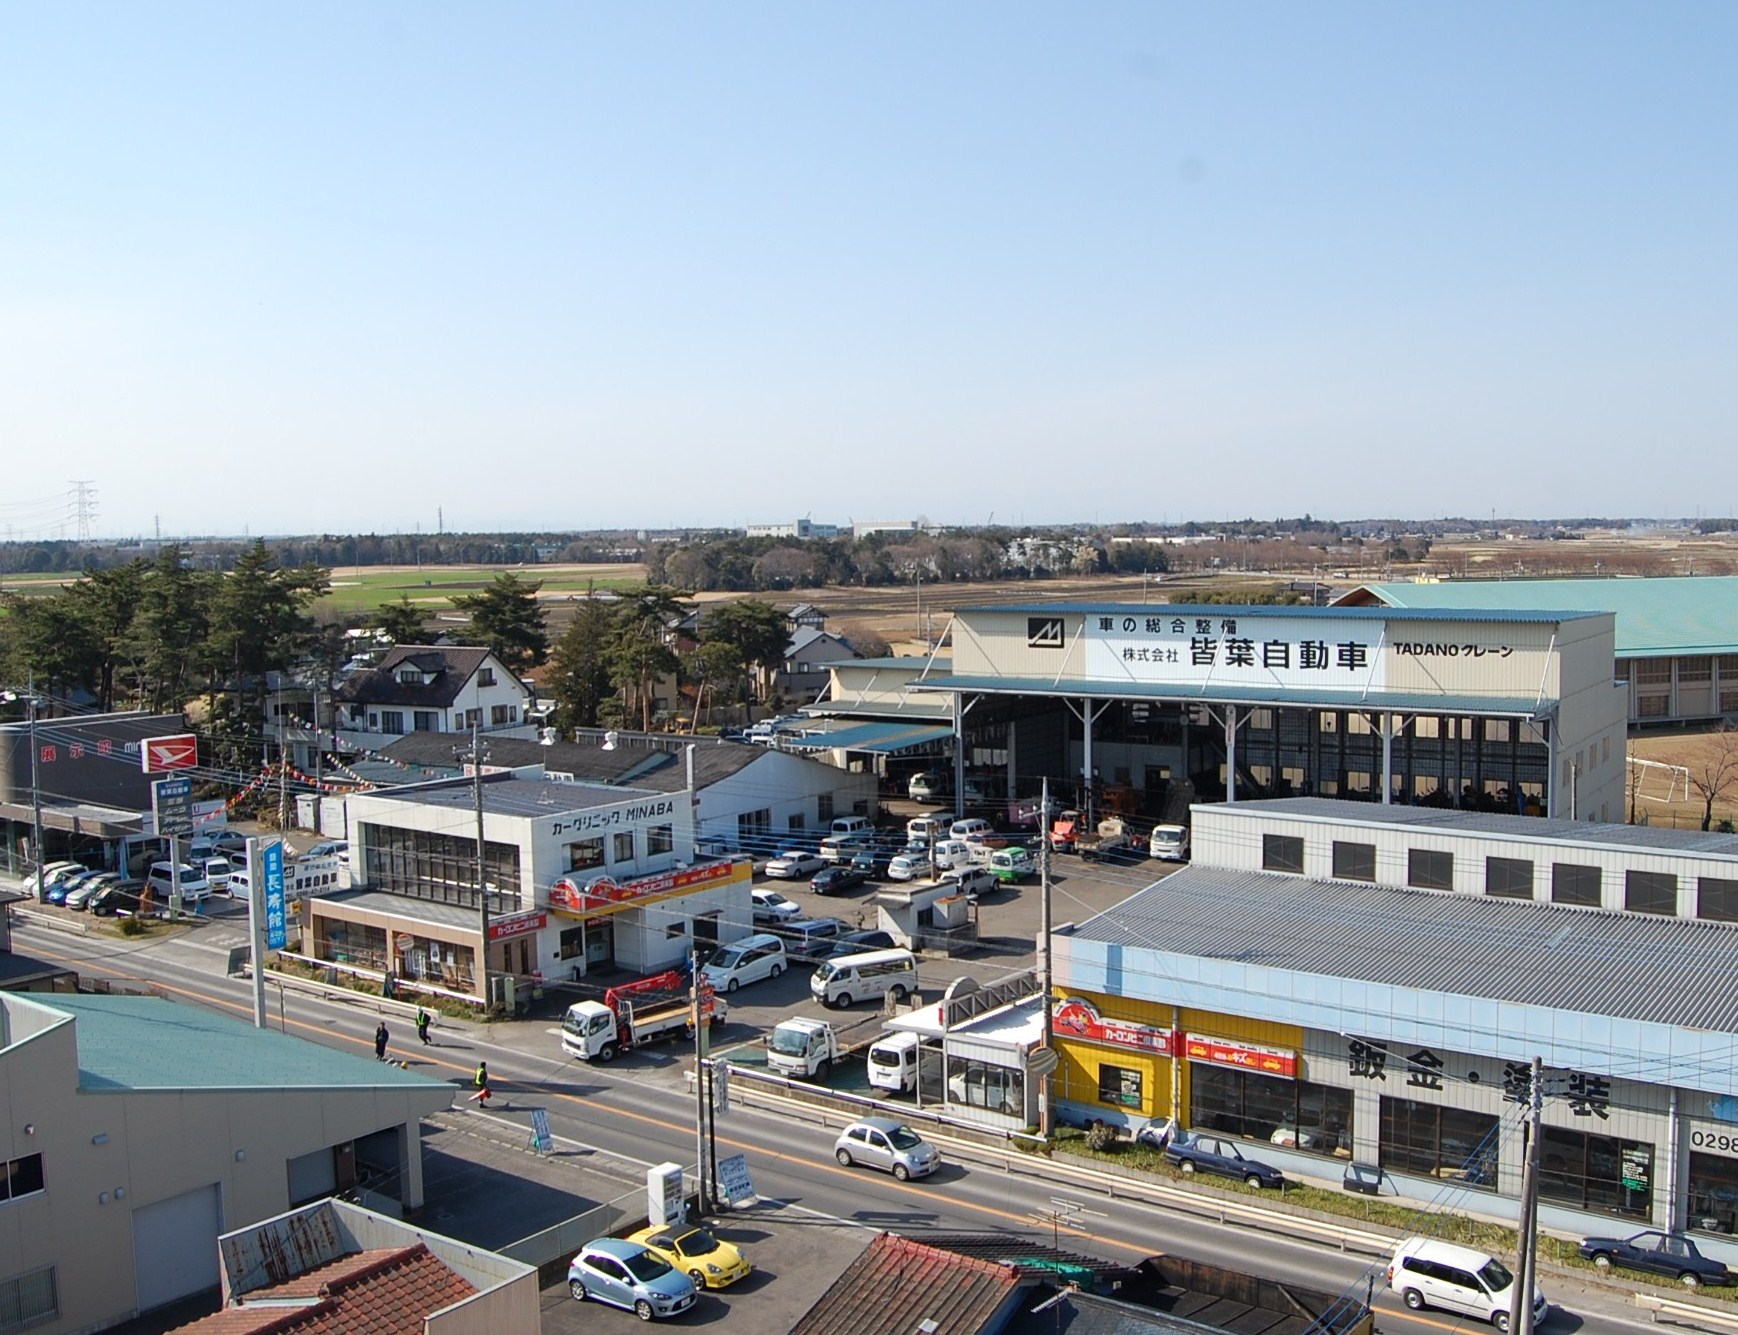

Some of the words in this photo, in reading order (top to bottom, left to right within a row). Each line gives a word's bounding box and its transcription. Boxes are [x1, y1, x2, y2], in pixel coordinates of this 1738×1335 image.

[1098, 617, 1237, 635] 車の総合整備
[1122, 647, 1180, 662] 株式会社
[1189, 637, 1368, 672] 皆葉自動車
[626, 801, 674, 821] MINABA
